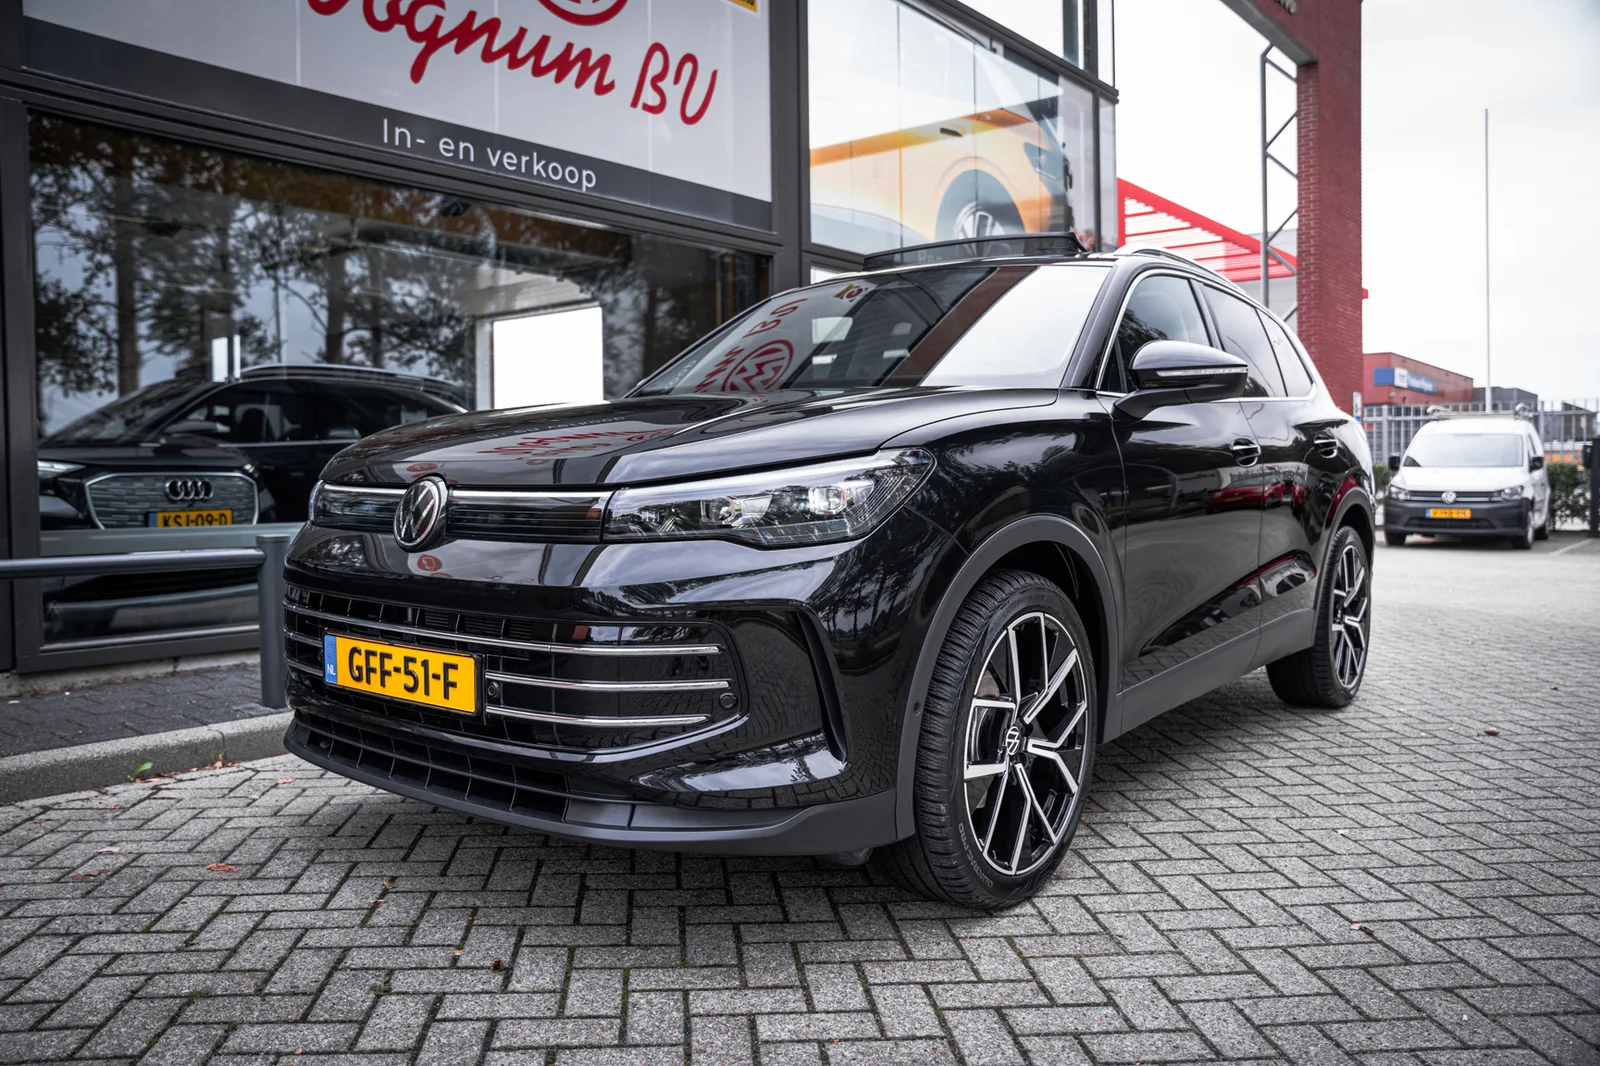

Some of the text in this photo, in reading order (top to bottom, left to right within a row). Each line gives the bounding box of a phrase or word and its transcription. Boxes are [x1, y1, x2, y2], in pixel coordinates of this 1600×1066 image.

[307, 0, 719, 126] ognum BV
[382, 118, 598, 193] In- en verkoop
[326, 663, 337, 677] NL
[348, 645, 459, 700] GFF-51-F
